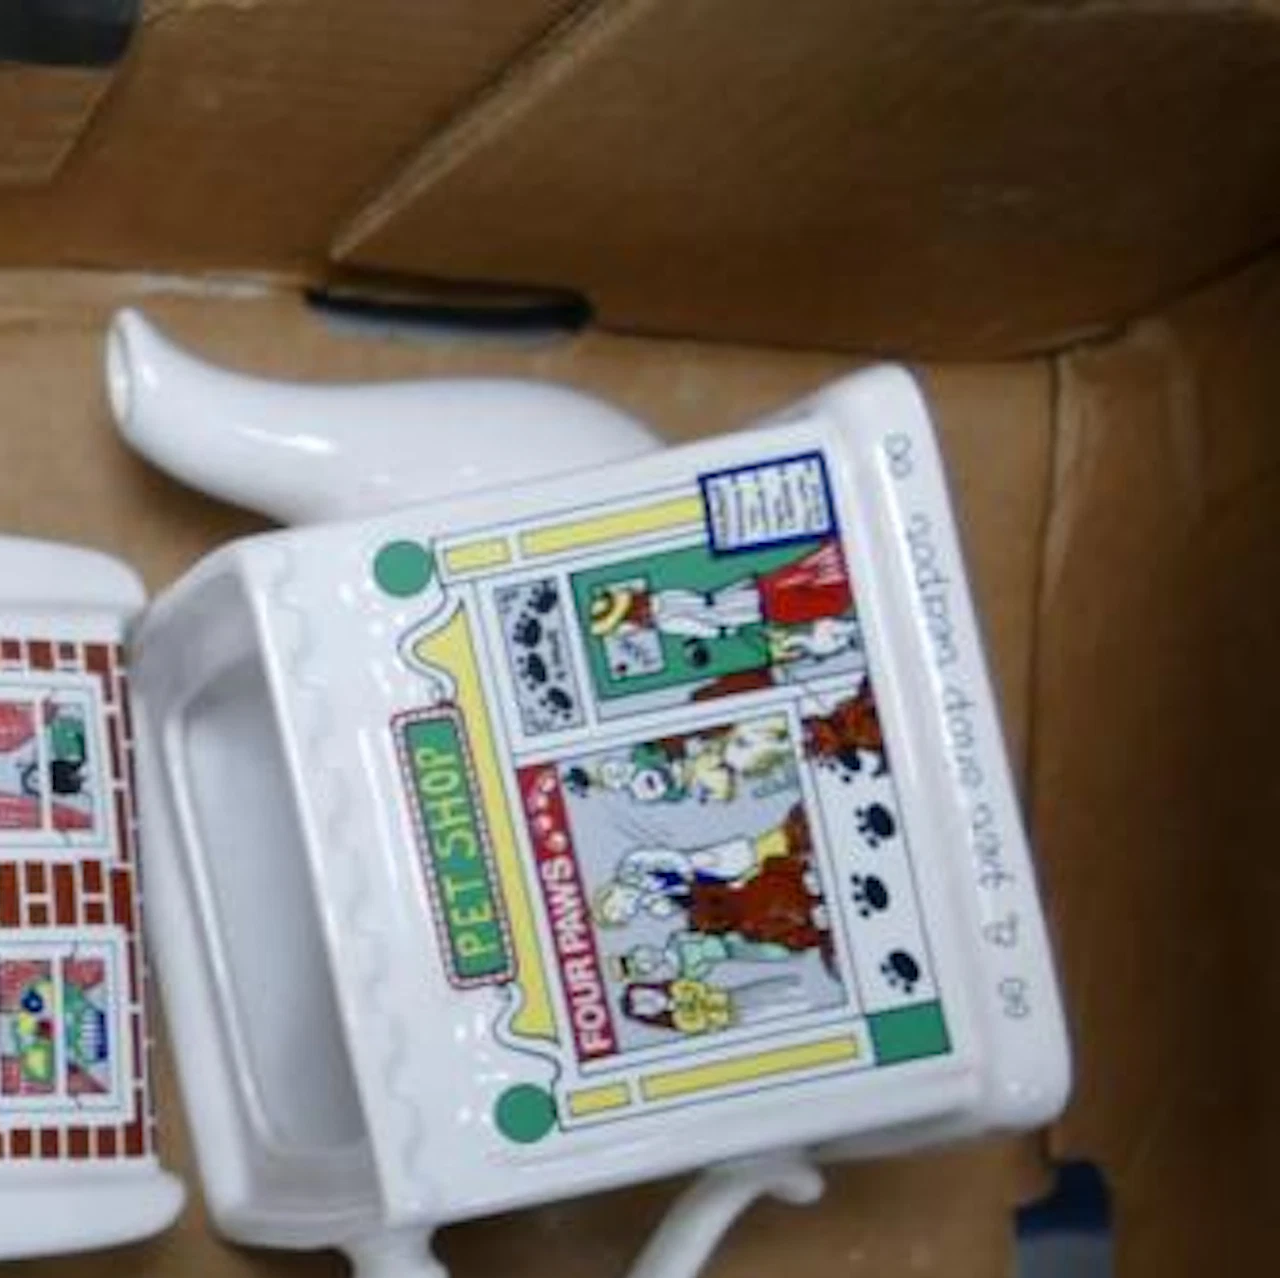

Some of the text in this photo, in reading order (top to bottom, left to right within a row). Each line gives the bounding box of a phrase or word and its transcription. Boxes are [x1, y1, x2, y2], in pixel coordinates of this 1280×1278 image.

[415, 747, 493, 958] PET SHOP
[540, 855, 615, 1053] FOUR PAWS
